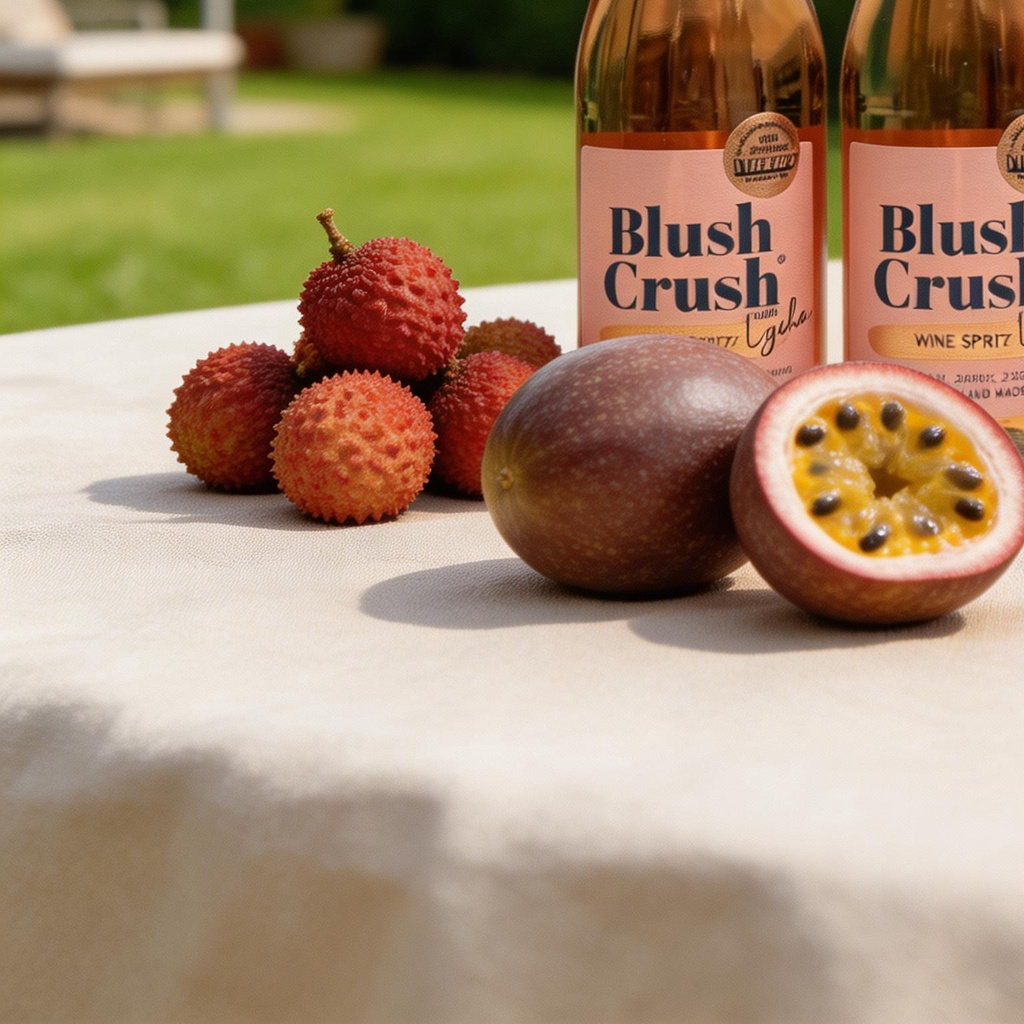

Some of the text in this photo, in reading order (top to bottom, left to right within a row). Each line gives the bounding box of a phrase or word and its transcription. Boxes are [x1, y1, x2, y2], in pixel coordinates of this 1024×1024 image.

[608, 202, 773, 258] Blush
[604, 257, 779, 312] Crush
[915, 333, 955, 349] WINE
